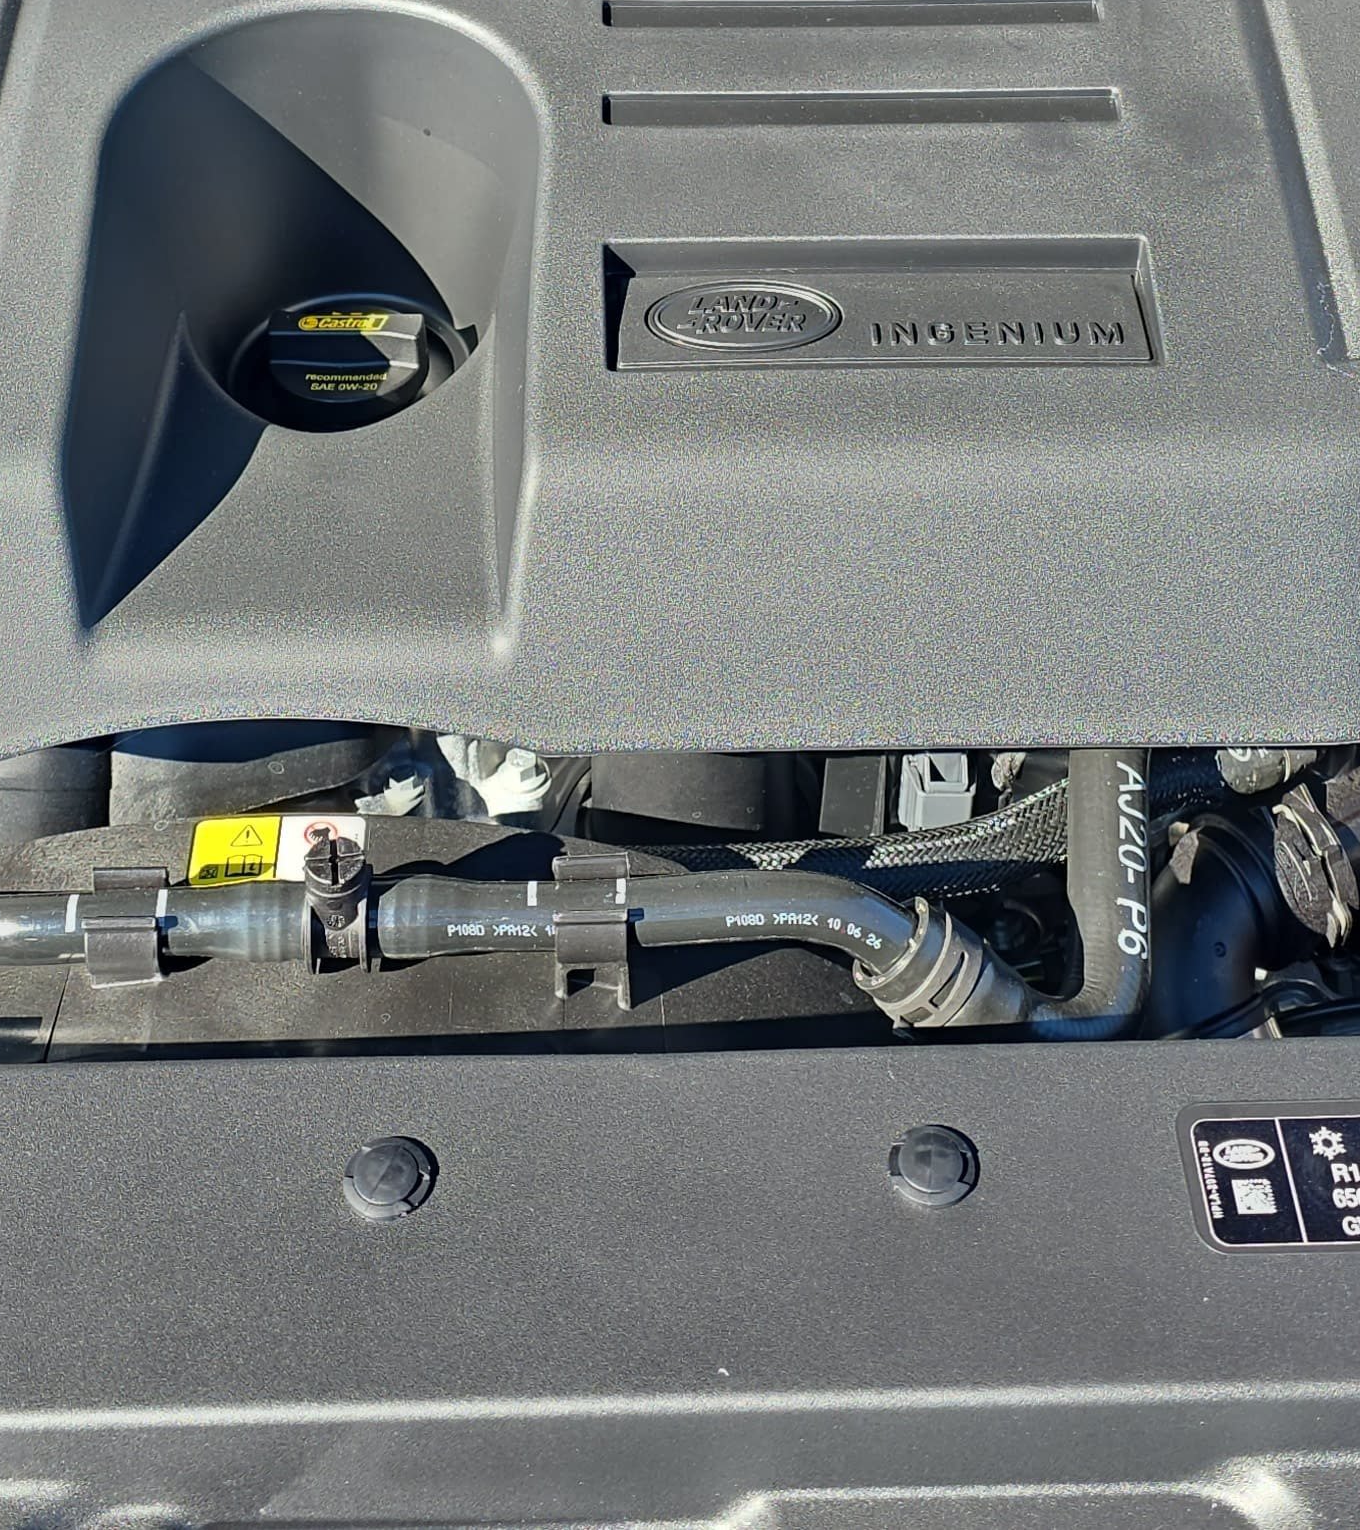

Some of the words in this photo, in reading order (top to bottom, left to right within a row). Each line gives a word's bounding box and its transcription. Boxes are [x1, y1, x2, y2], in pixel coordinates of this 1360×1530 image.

[687, 295, 779, 315] LAND
[318, 316, 376, 329] Castrol
[695, 313, 807, 335] ROVER
[869, 320, 1124, 346] INGENIUM
[305, 373, 388, 382] recommended
[310, 382, 336, 391] SAE
[337, 382, 378, 391] 0W-20
[1115, 896, 1149, 960] P6
